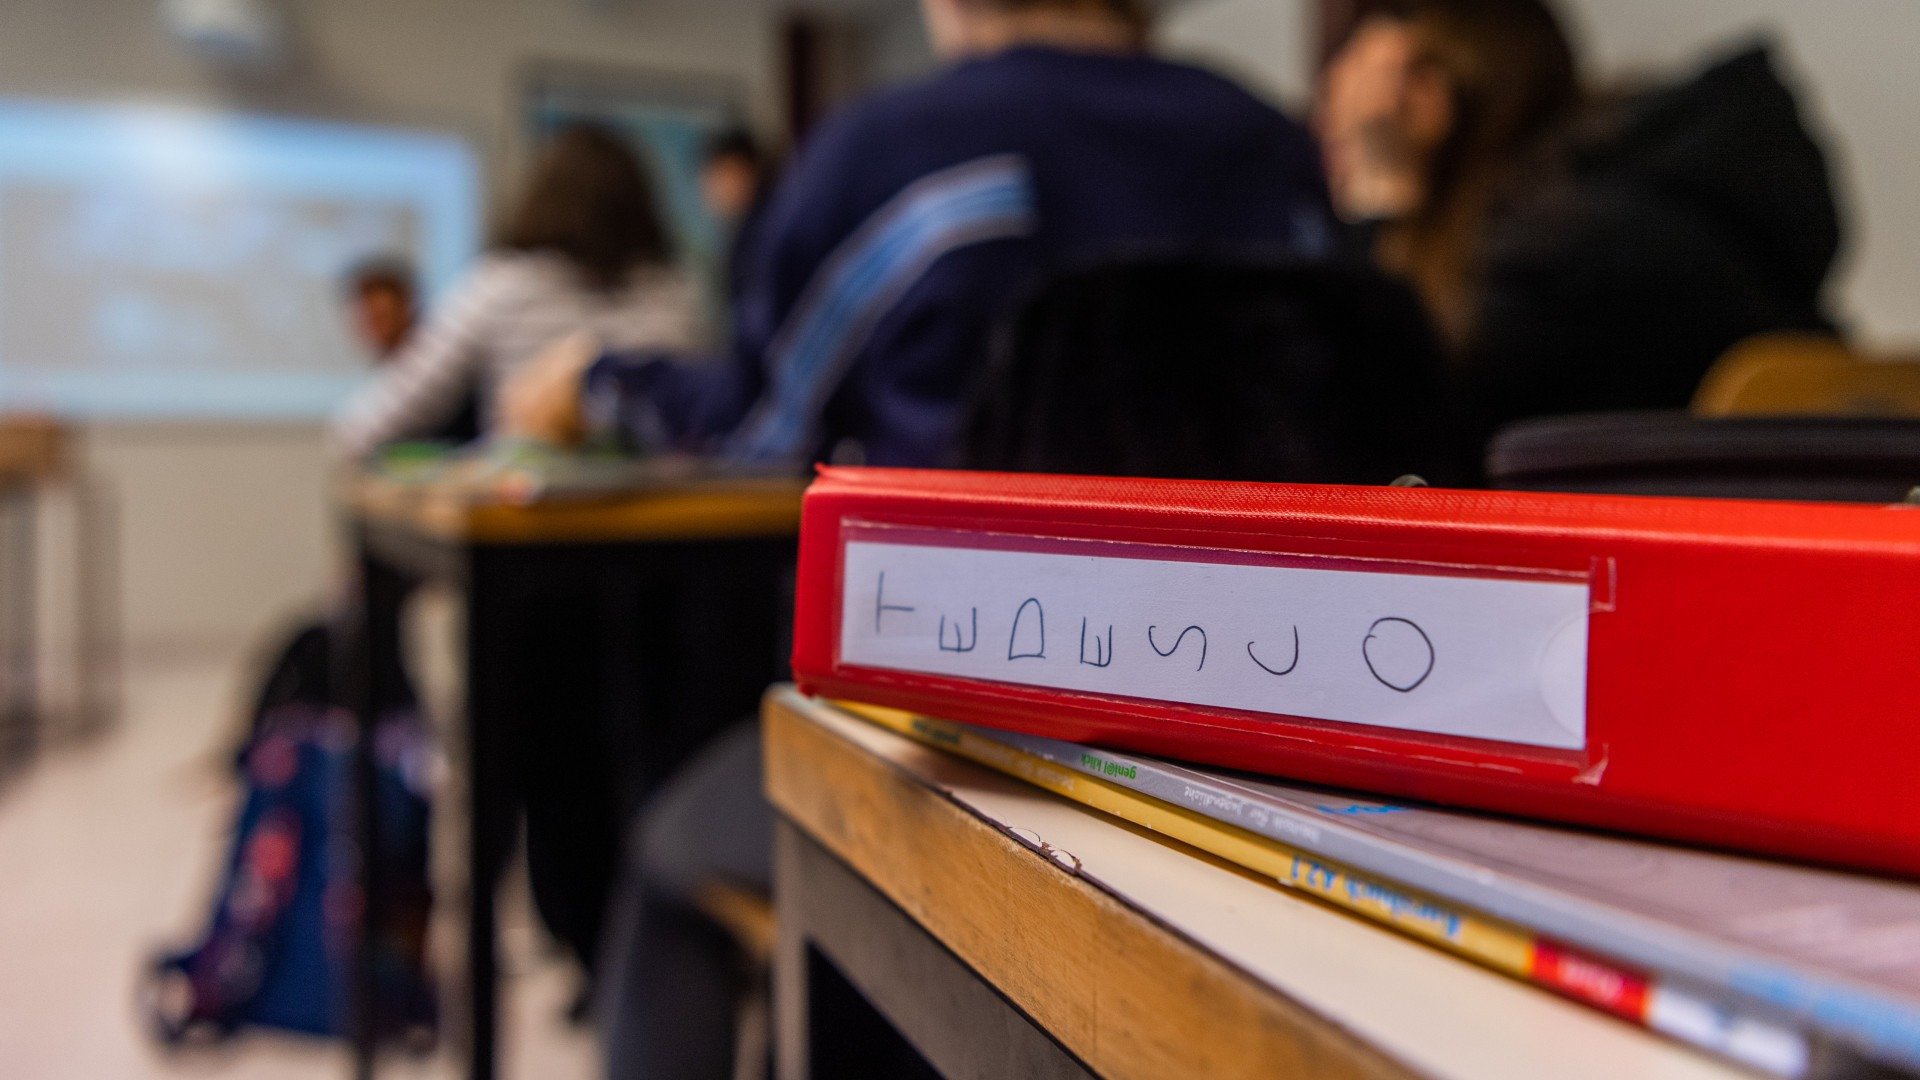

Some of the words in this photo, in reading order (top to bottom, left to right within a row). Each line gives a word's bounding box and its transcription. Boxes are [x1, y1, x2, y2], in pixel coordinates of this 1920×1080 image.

[875, 570, 1435, 692] TEDESCO
[1079, 751, 1102, 770] klick
[1103, 760, 1137, 780] geni@l
